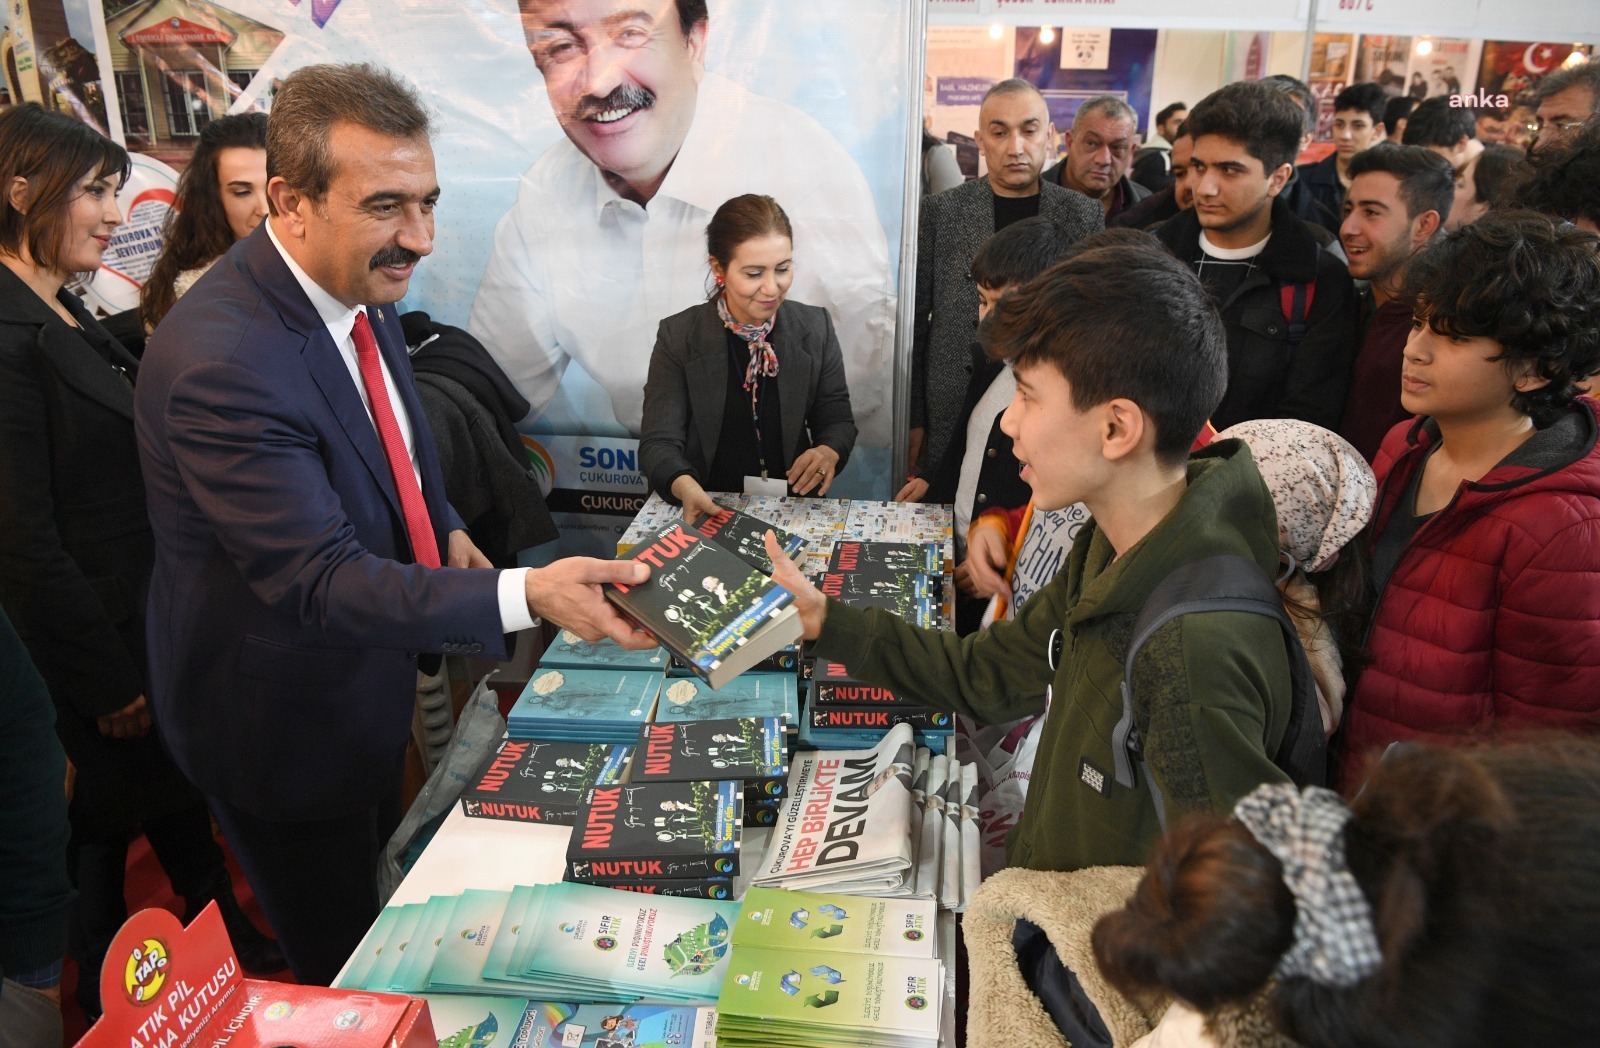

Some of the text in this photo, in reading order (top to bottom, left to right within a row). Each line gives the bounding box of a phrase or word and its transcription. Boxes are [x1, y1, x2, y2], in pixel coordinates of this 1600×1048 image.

[580, 472, 644, 486] ÇUKUROVA
[837, 543, 860, 570] NUTUK
[710, 633, 737, 658] Soner
[733, 615, 759, 639] Çetin
[836, 687, 894, 700] NUTUK
[830, 712, 888, 725] NUTUK
[644, 724, 675, 774] NUTUK
[476, 741, 530, 791] NUTUK
[481, 802, 541, 820] NUTUK
[582, 787, 621, 848] NUTUK
[770, 759, 813, 873] ÇUKUROVA'YI GÜZELLEŞTİRMEYE
[815, 752, 879, 866] DEVAM
[723, 823, 733, 841] Soner
[592, 861, 663, 876] NUTUK
[786, 838, 818, 872] HEP
[599, 915, 612, 934] SIFIR
[609, 917, 622, 935] ATIK
[905, 914, 915, 928] SIFIR
[917, 914, 925, 928] ATIK
[135, 949, 159, 982] TAP
[178, 956, 236, 1031] KUTUSU
[907, 976, 916, 994] SIFIR
[917, 977, 927, 994] ATIK
[211, 984, 236, 1014] Arayınız
[131, 980, 194, 1048] ATIK PİL
[224, 996, 262, 1033] İÇİNDİR
